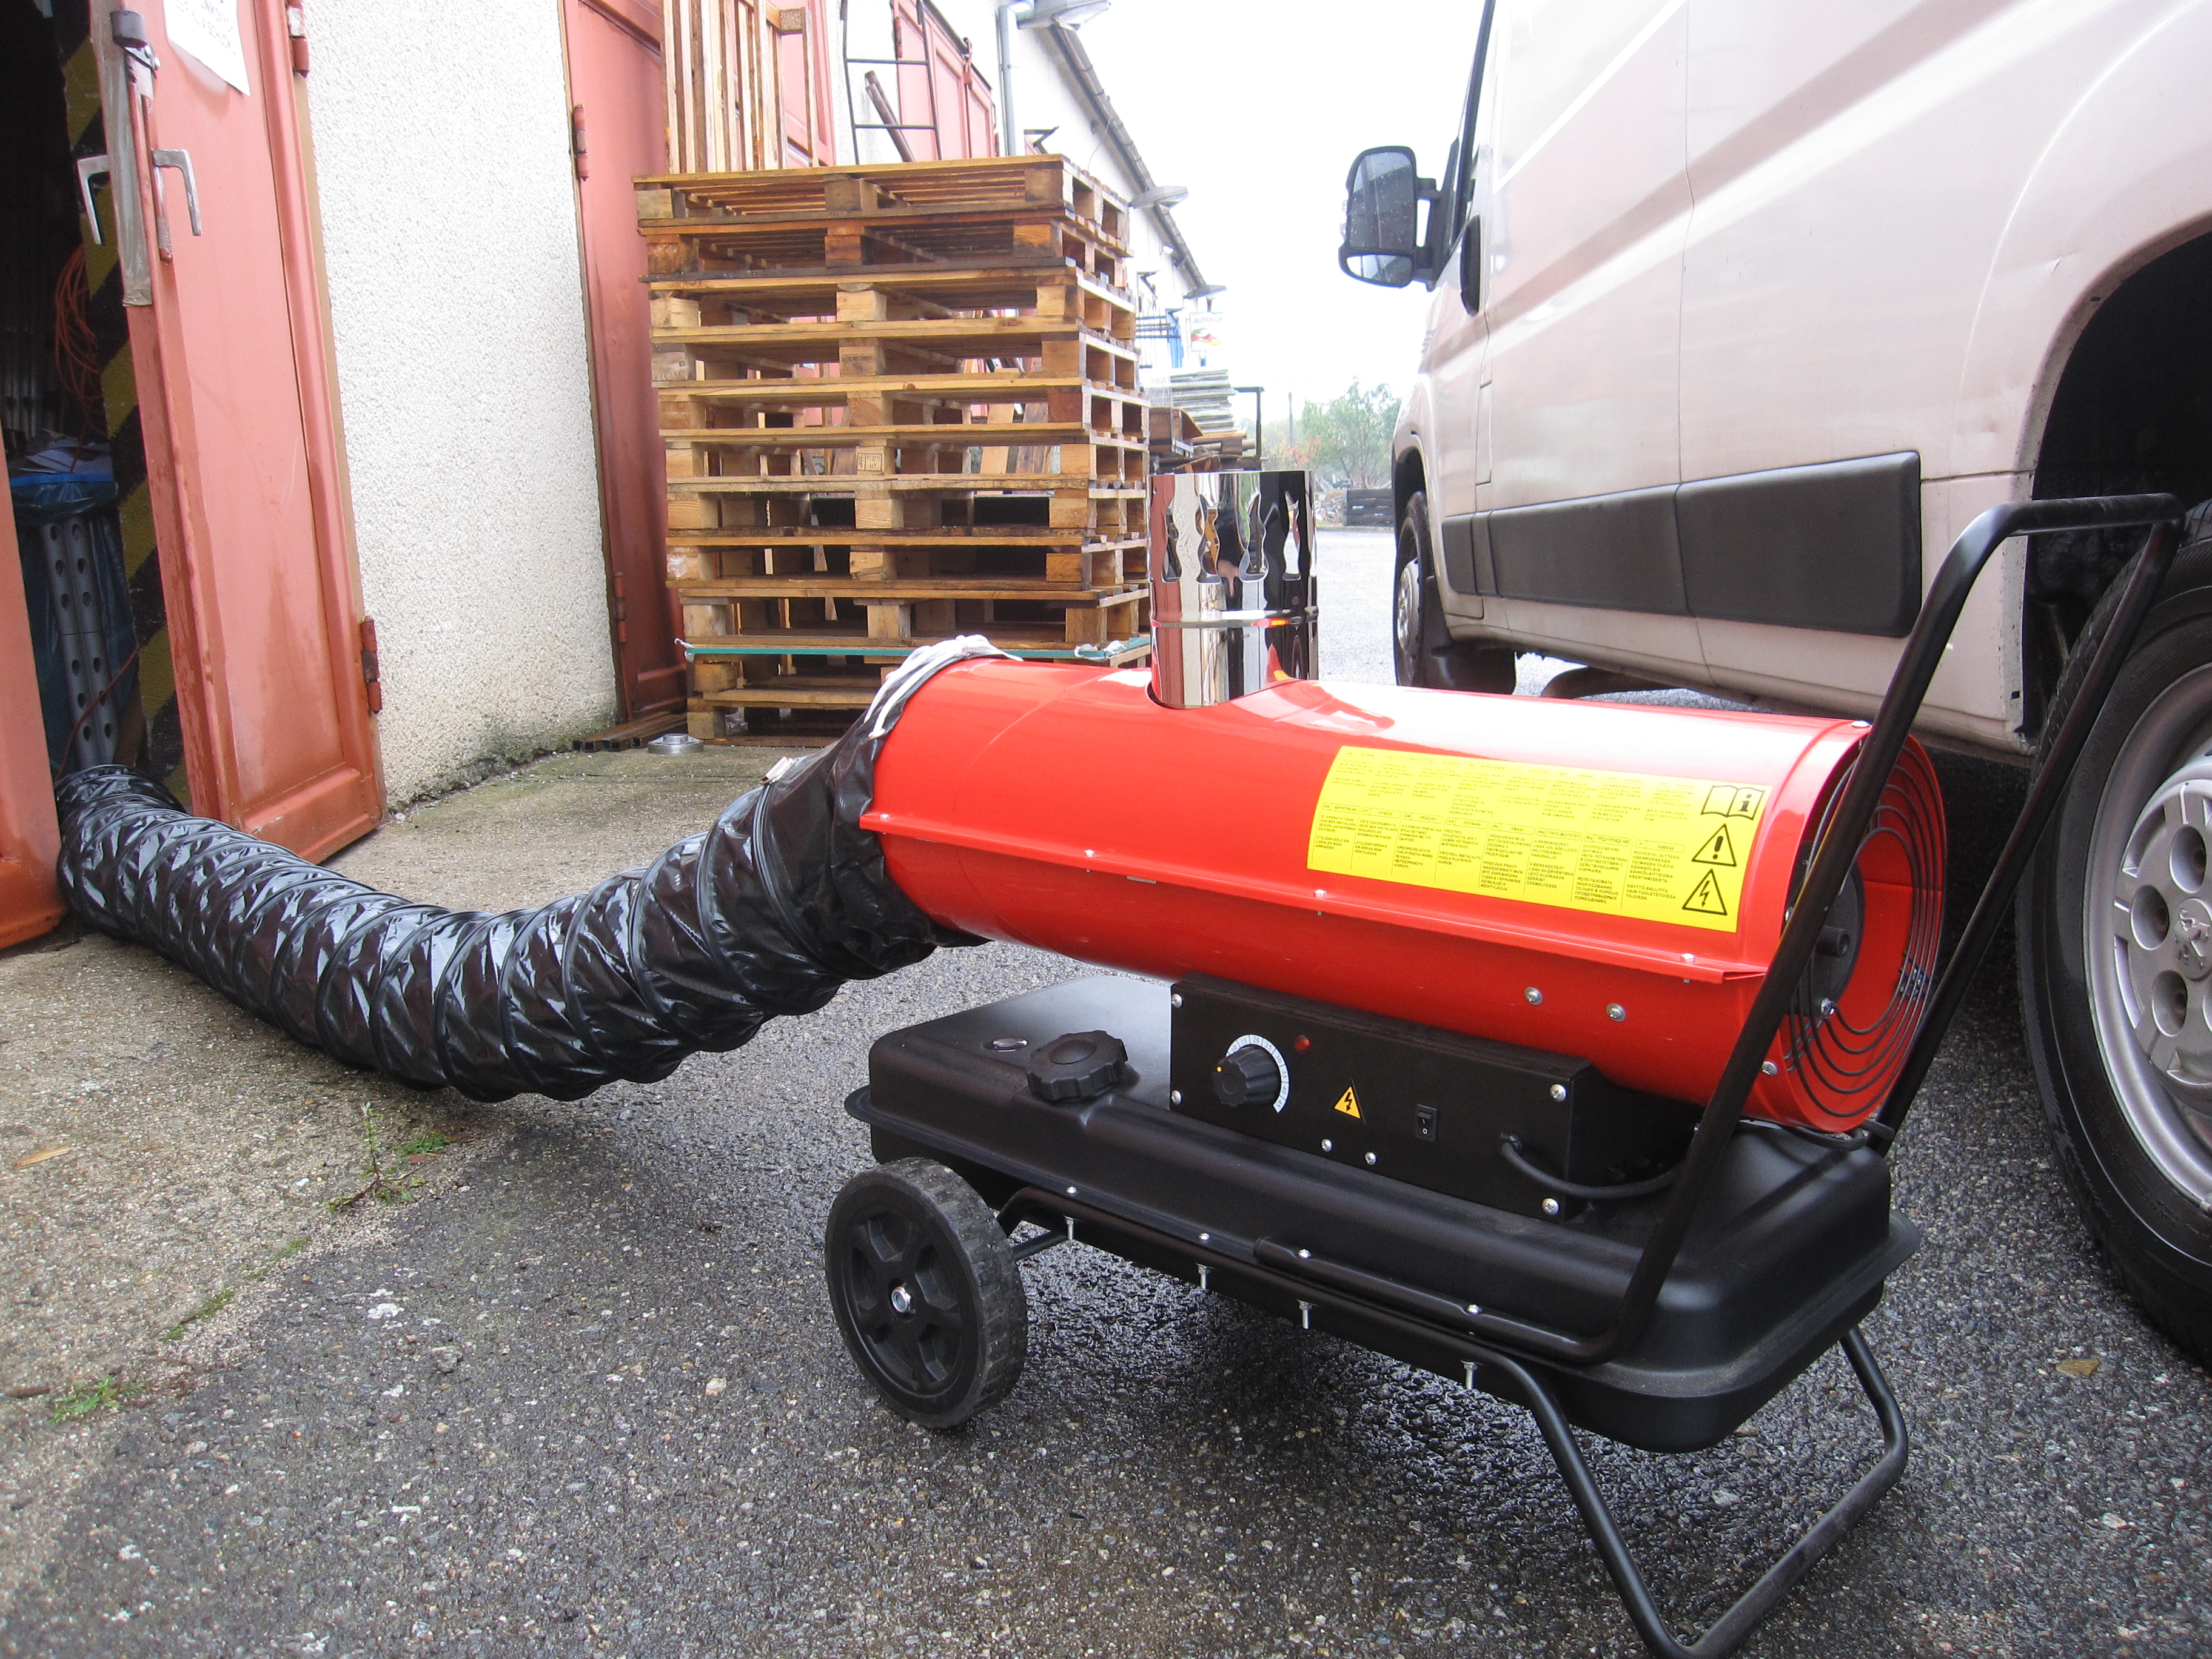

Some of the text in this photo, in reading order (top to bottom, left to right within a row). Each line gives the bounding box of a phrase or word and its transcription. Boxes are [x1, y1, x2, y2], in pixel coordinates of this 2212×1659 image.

[1275, 1054, 1282, 1063] 30
[1281, 1070, 1287, 1079] 35
[1282, 1086, 1288, 1094] 40
